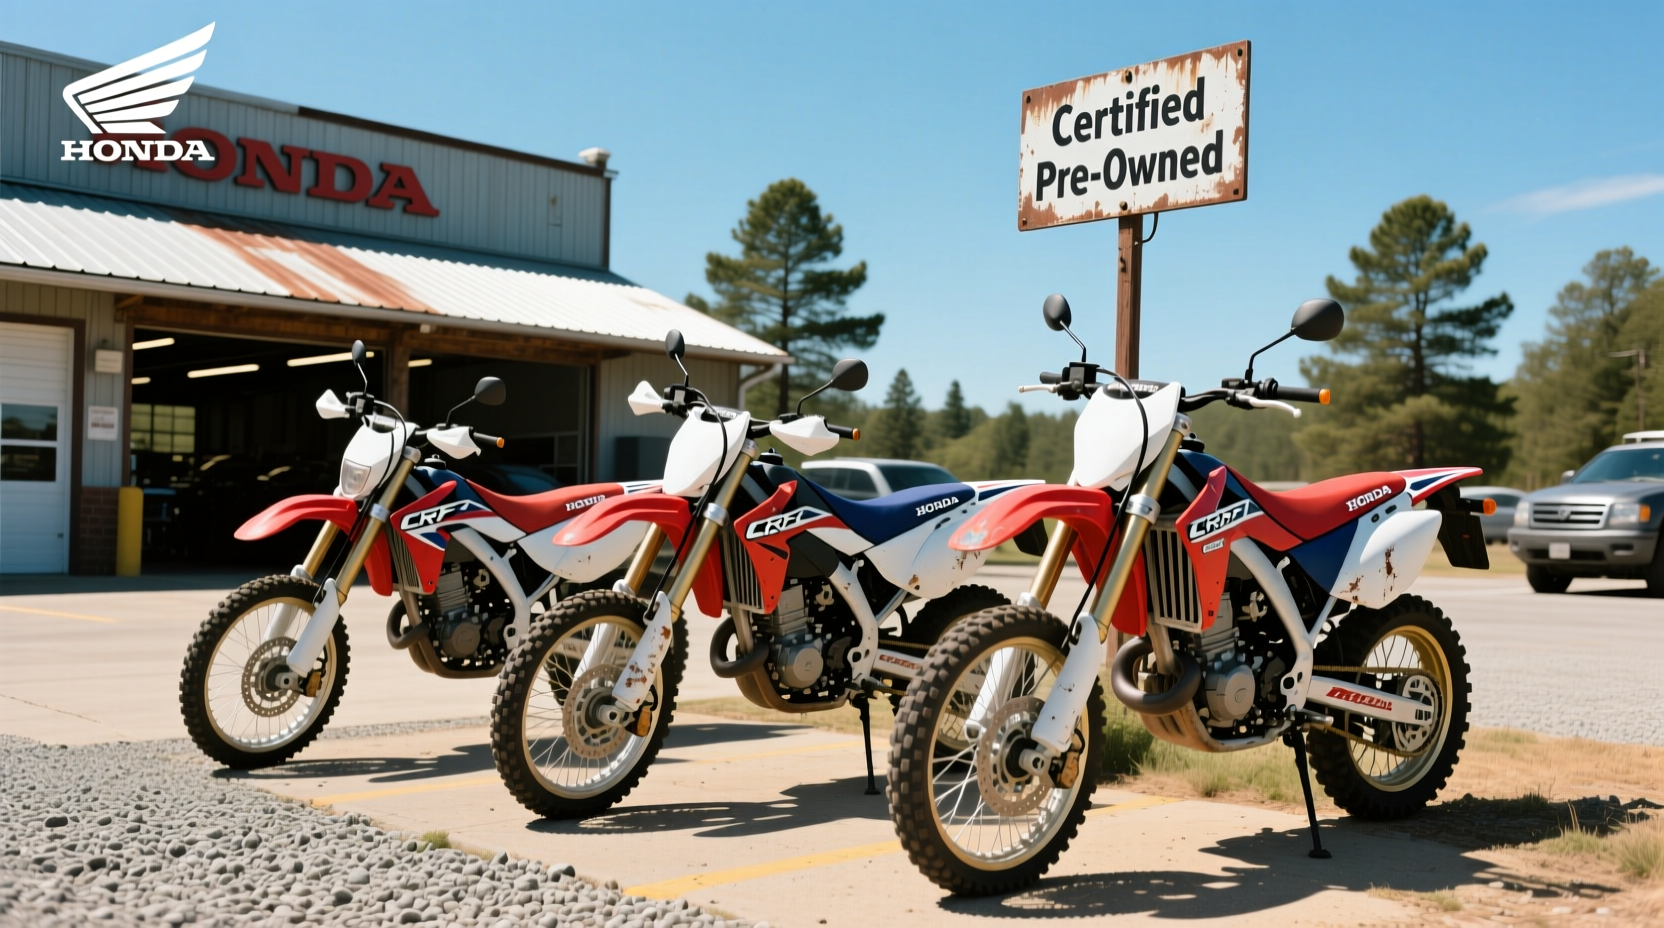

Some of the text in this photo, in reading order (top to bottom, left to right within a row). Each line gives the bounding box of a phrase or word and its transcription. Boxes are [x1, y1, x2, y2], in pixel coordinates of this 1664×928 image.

[1052, 76, 1206, 147] Certified
[1035, 129, 1224, 202] Pre-Owned
[915, 496, 960, 517] HONDA
